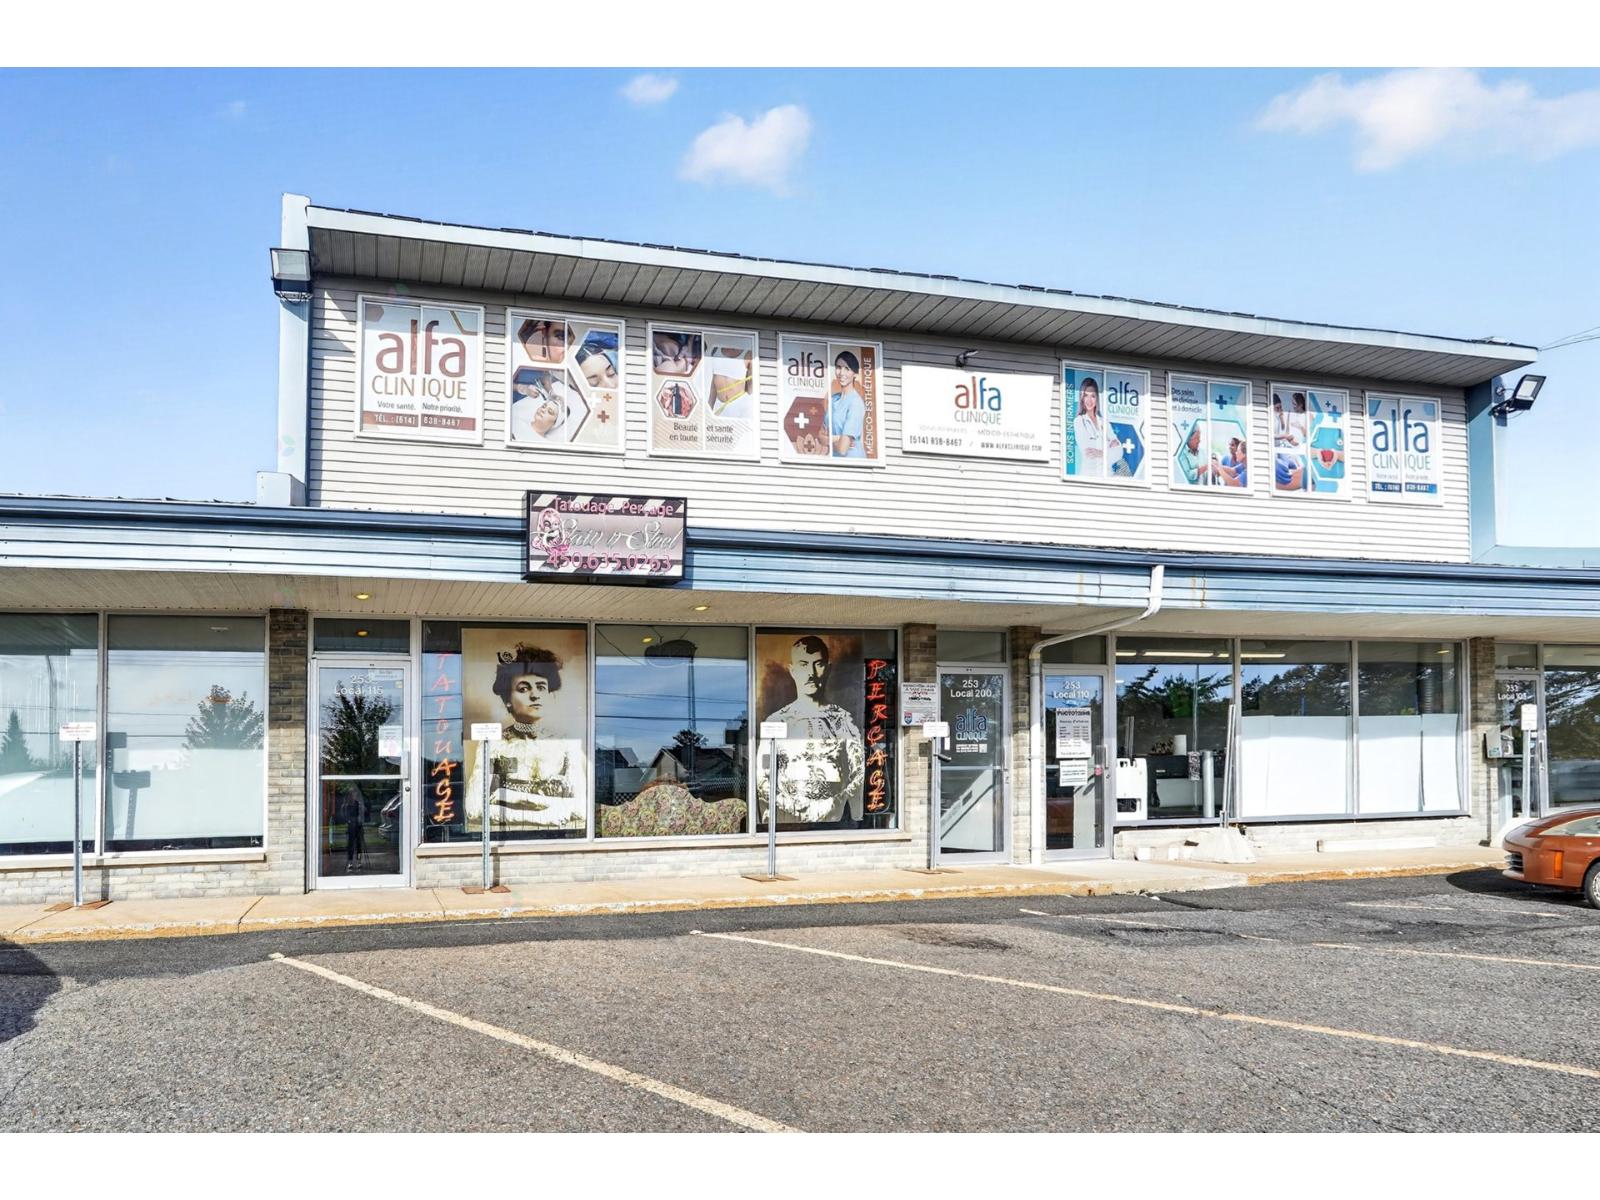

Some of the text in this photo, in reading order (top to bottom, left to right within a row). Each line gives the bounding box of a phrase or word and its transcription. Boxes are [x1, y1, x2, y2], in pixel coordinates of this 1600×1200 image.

[375, 319, 467, 378] alfa
[787, 351, 825, 378] alfa
[371, 375, 467, 401] CLINIQUE
[787, 376, 825, 388] CLINIQUE
[954, 375, 1002, 411] alfa
[1107, 381, 1139, 407] alfa
[377, 401, 395, 409] Votre
[422, 402, 439, 411] Notre
[1107, 403, 1139, 415] CLINIQUE
[954, 409, 1001, 425] CLINIQUE
[1065, 383, 1075, 464] SOINS INFIRMIERS
[673, 422, 734, 434] Beauté et santé
[1372, 408, 1430, 454] alfa
[679, 433, 698, 441] toute
[706, 434, 734, 444] sécurité
[909, 436, 929, 445] (514)
[930, 436, 962, 447] 838-8467
[1372, 453, 1431, 472] CLINIQUE
[554, 496, 674, 519] Tatouage Perçage
[547, 550, 673, 573] 450.635.0263
[334, 685, 363, 696] Local
[962, 679, 979, 688] 253
[1064, 680, 1081, 690] 253
[950, 689, 992, 698] Local 200
[1053, 690, 1075, 699] Local
[955, 708, 987, 731] alfa
[431, 653, 458, 823] TATOUAGE
[865, 658, 889, 812] PERÇAGE
[955, 730, 988, 743] CLINIQUE
